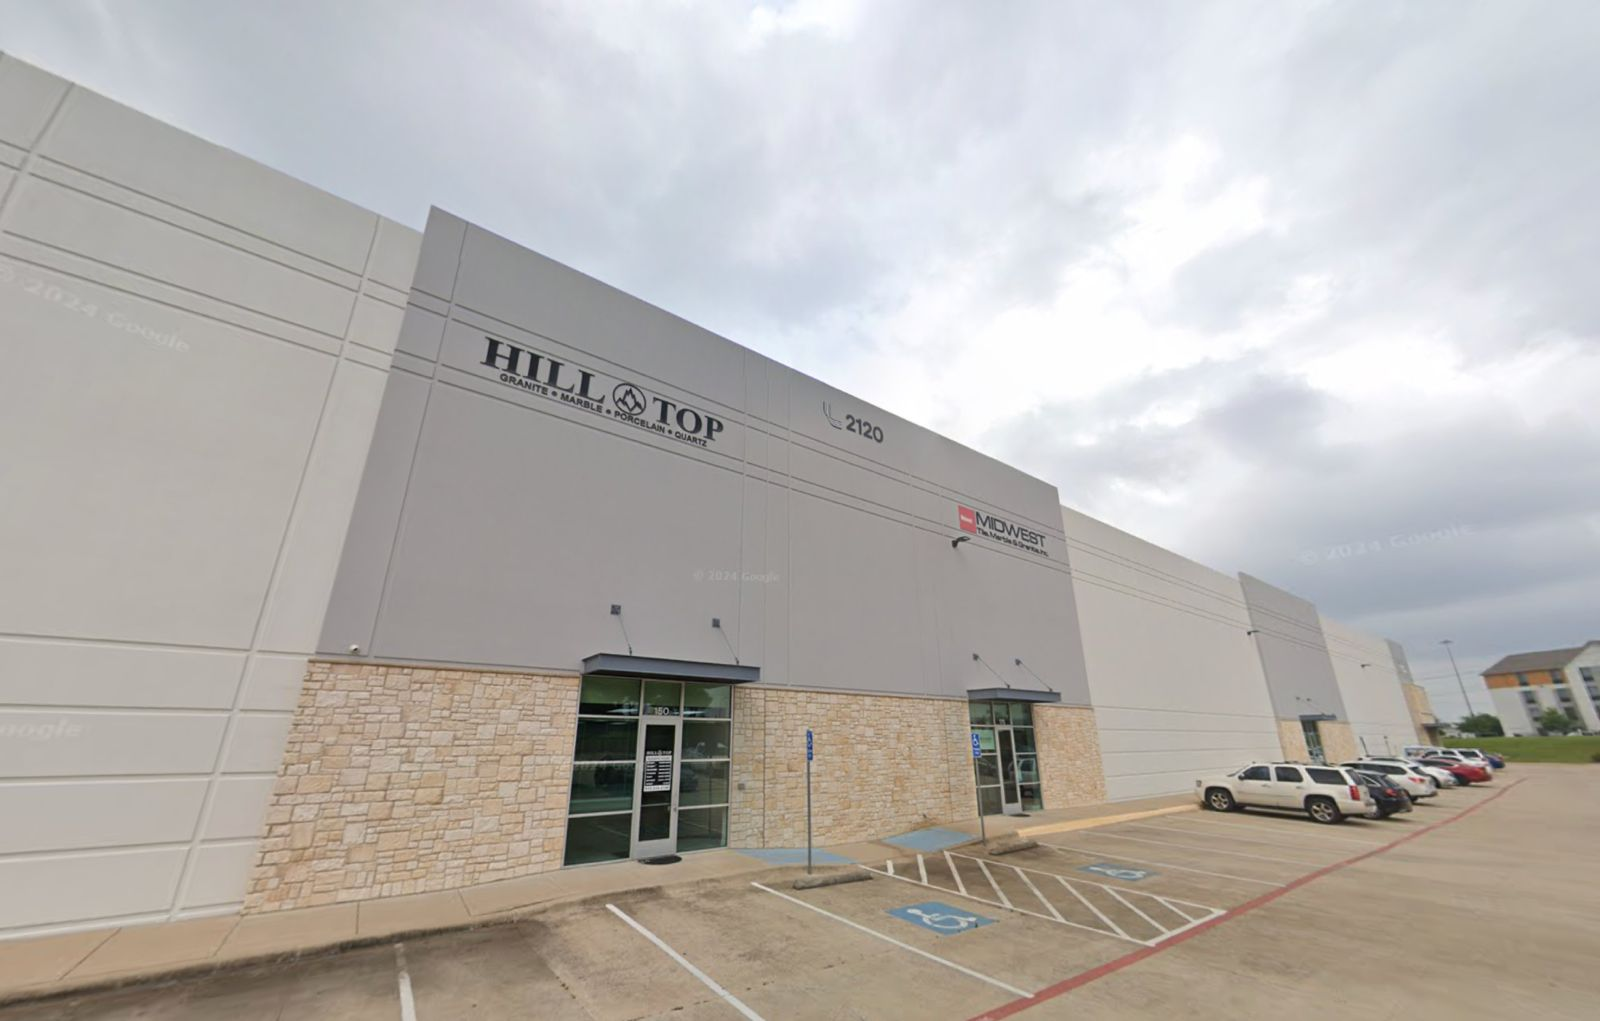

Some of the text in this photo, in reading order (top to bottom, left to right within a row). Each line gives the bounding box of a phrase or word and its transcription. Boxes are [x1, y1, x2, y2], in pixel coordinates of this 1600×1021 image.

[480, 336, 724, 442] HILL TOP
[500, 373, 707, 447] GRANITE MARBLE PORCELAIN QUARTZ
[846, 414, 884, 444] 2120
[976, 511, 1046, 548] MIDWEST
[654, 707, 670, 716] 150
